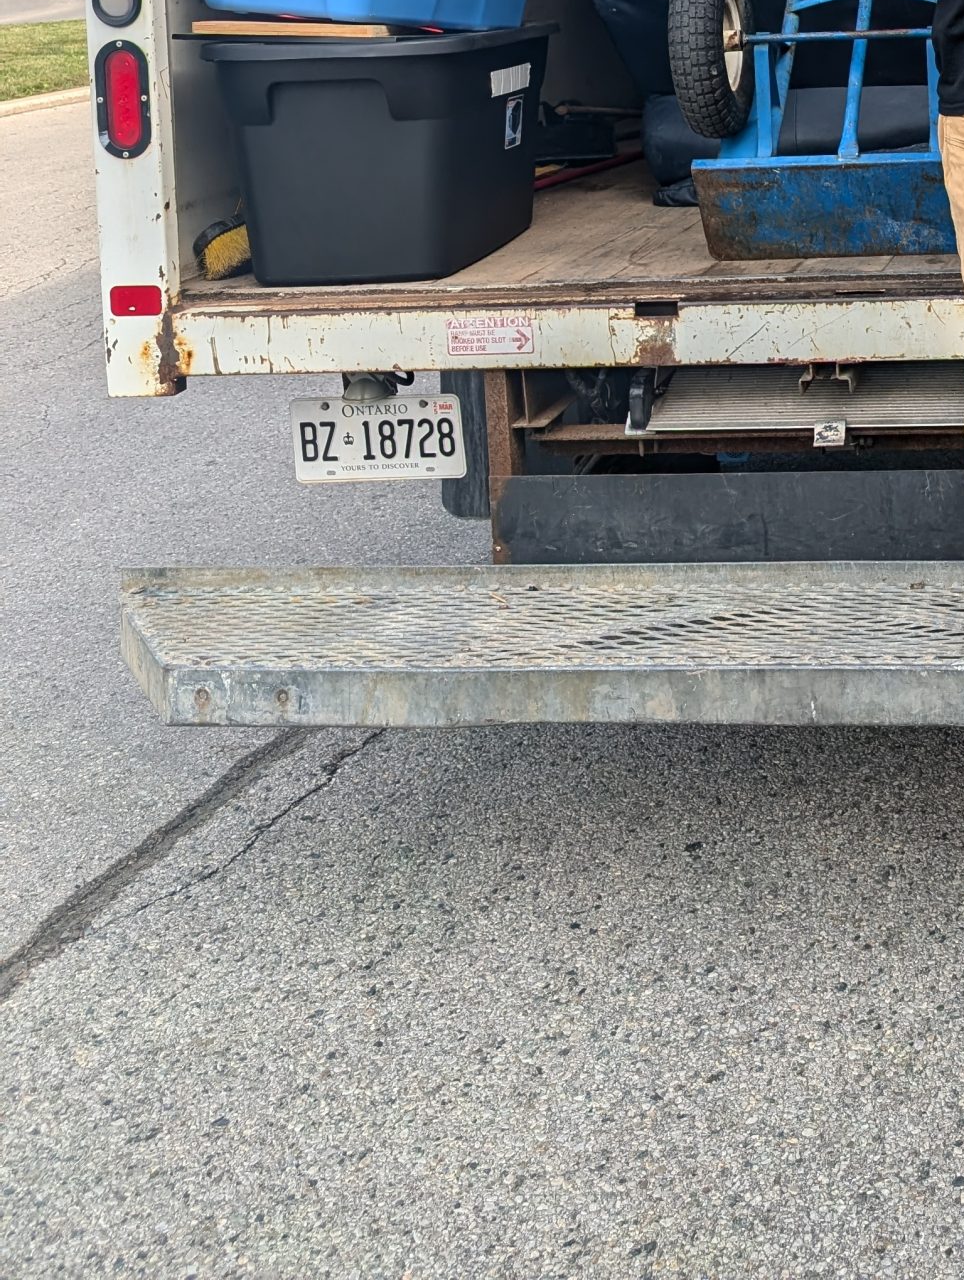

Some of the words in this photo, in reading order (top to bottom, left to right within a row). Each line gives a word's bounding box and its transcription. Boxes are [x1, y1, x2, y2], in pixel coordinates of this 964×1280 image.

[491, 336, 506, 344] SLOT
[300, 421, 339, 462] BZ
[362, 417, 456, 461] 18728
[381, 462, 420, 470] DISCOVER
